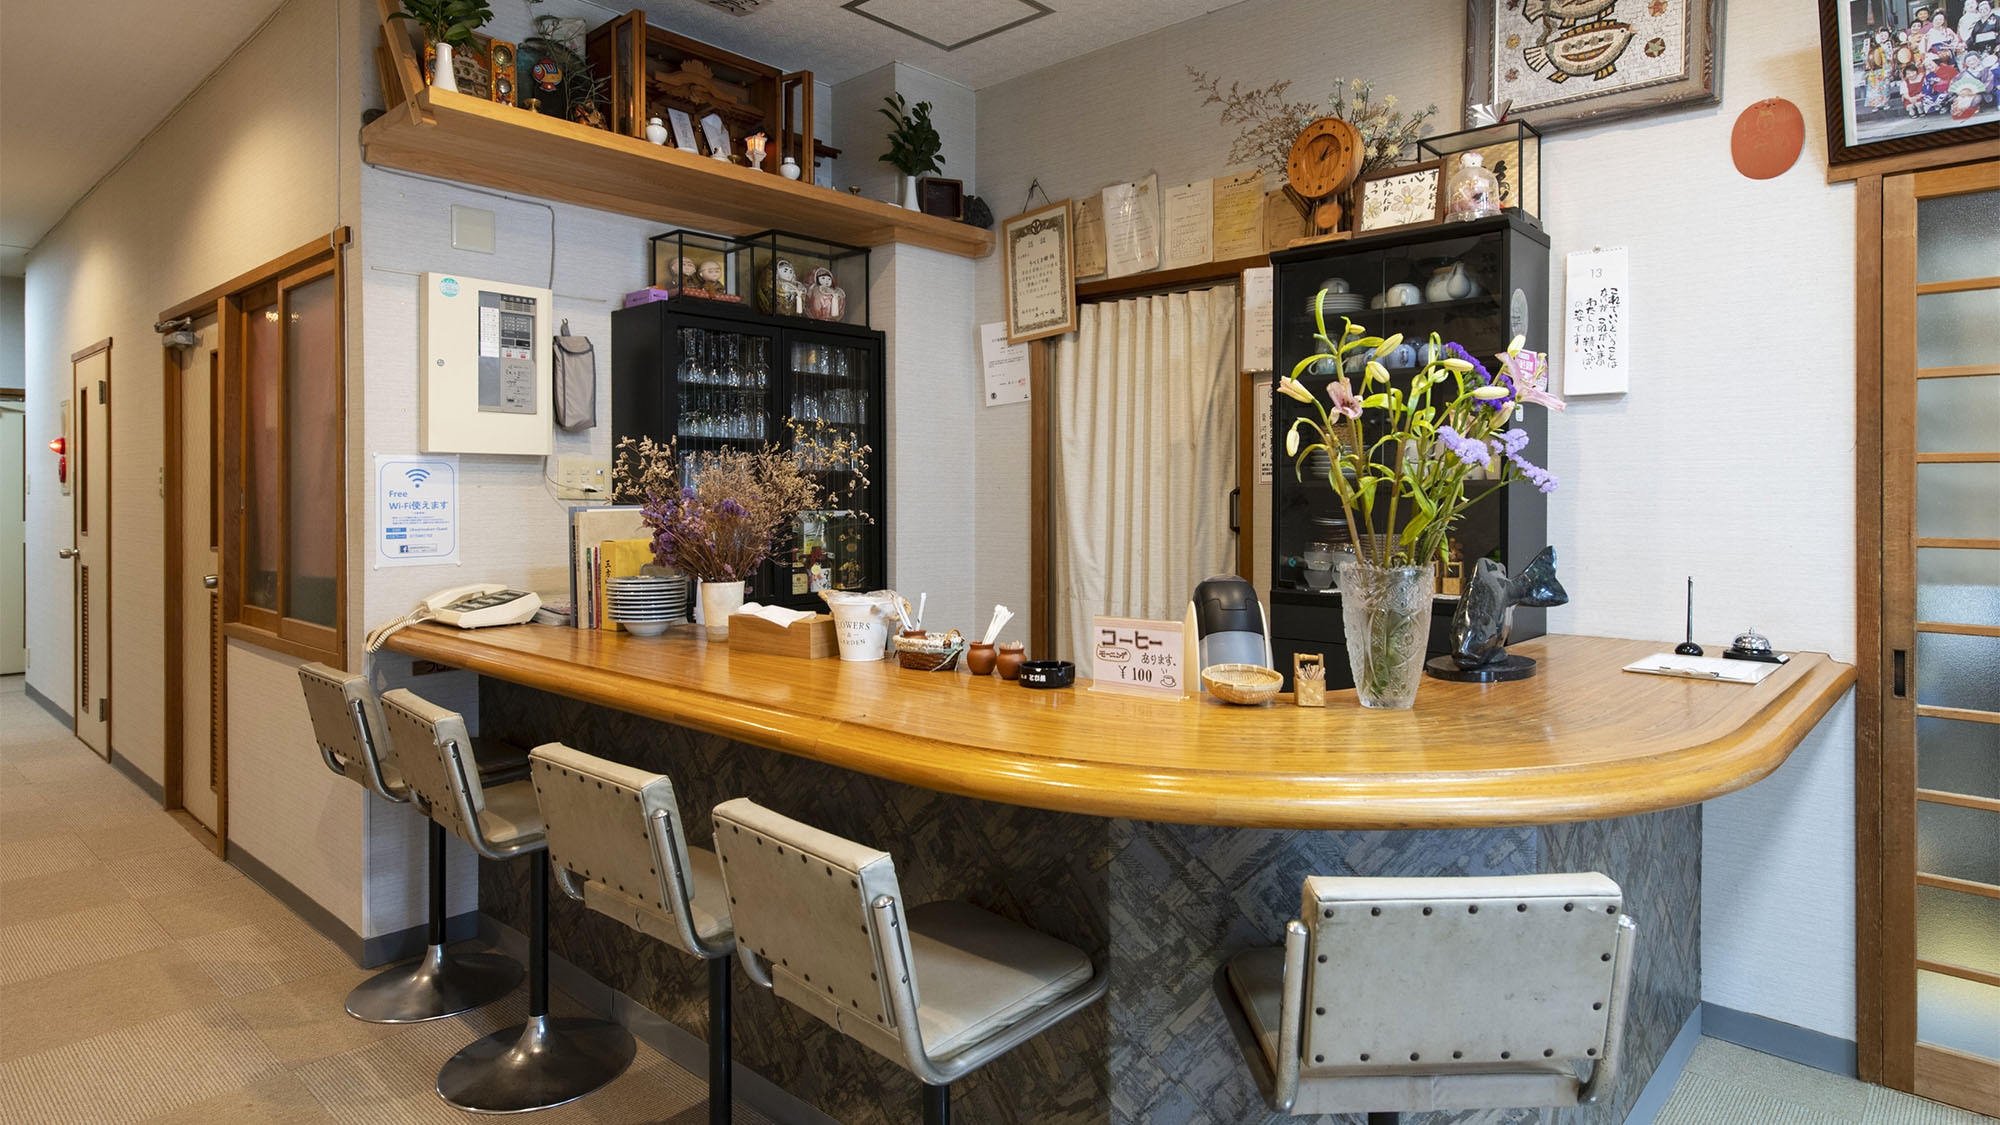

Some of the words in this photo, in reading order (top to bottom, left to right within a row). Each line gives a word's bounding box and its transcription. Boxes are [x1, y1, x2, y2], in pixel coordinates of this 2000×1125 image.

[1590, 268, 1603, 279] 13
[388, 490, 408, 498] Free
[389, 501, 448, 510] Wi-Fi使えます
[1101, 629, 1163, 650] コーヒー
[1098, 650, 1129, 660] モーニング
